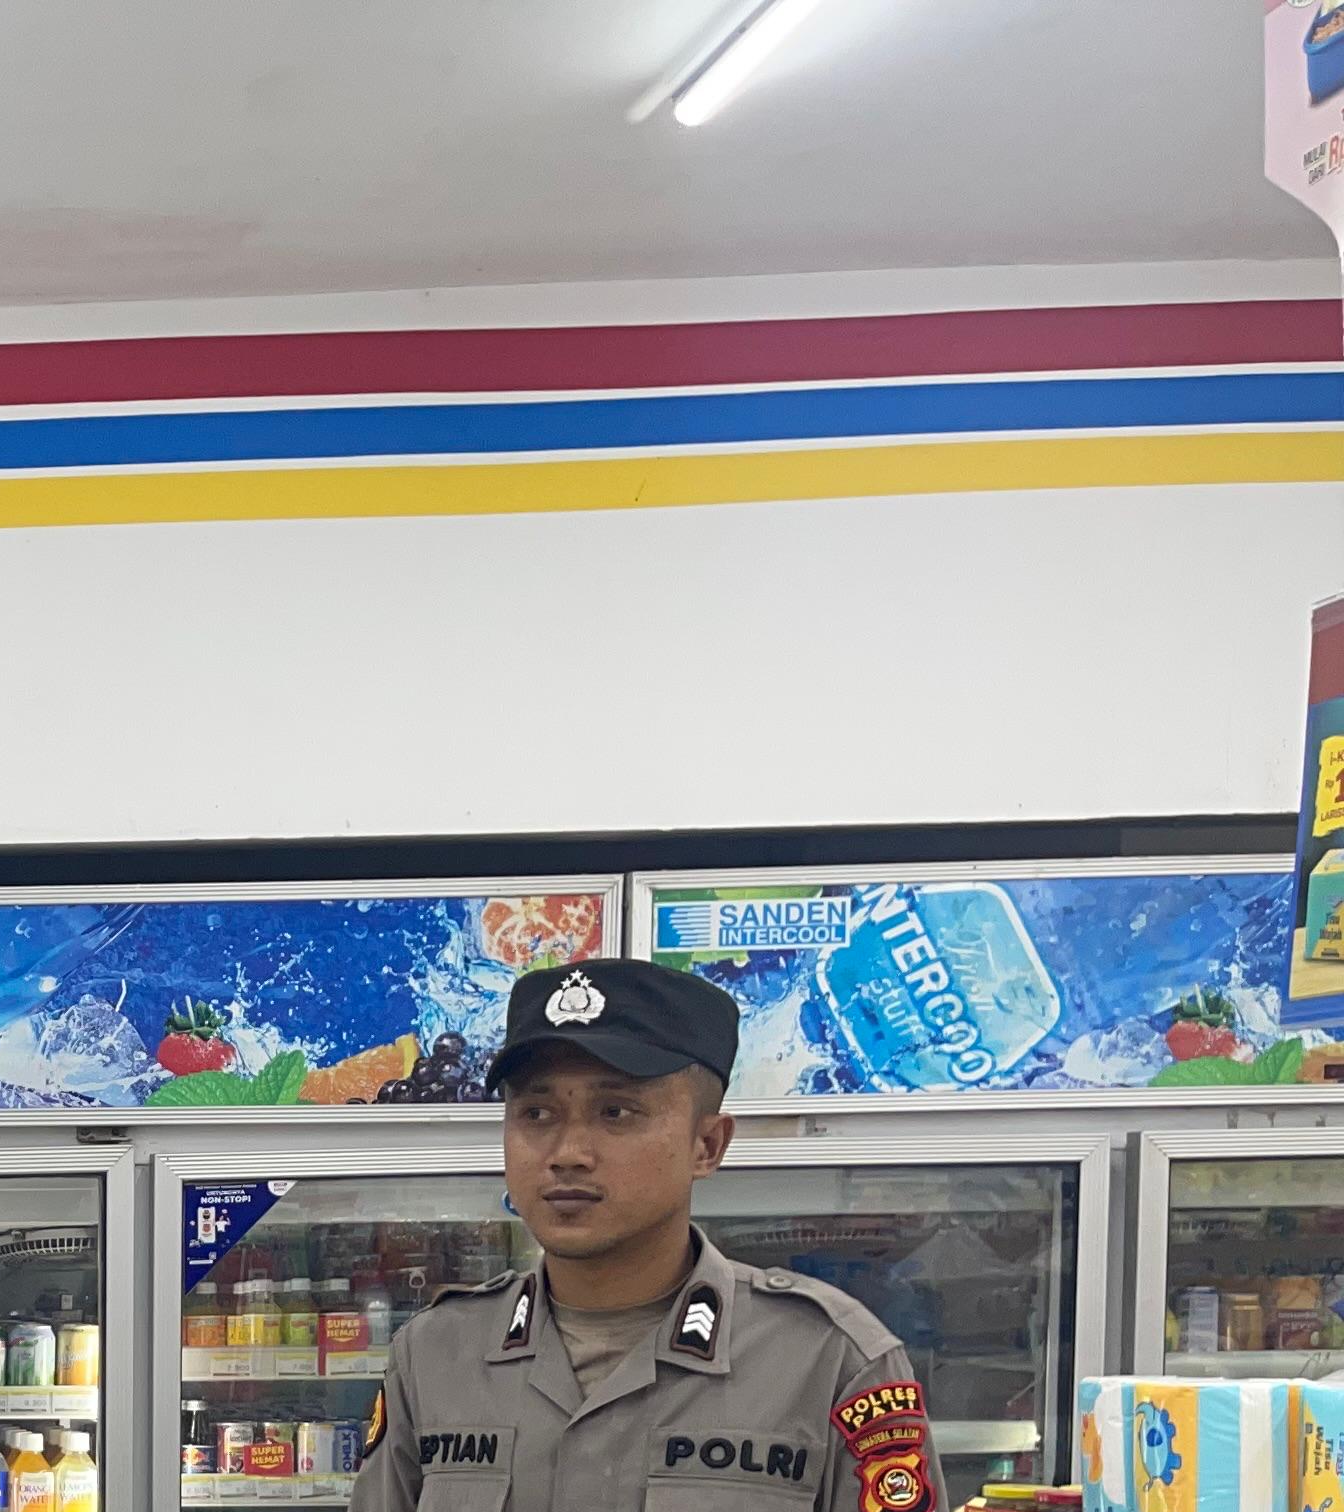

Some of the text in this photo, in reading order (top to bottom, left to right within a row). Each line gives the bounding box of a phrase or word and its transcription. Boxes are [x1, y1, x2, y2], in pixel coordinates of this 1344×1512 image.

[719, 902, 847, 925] SANDEN
[721, 927, 843, 944] INTERCOOL
[326, 1319, 360, 1329] SUPER
[326, 1328, 361, 1338] HEMAT
[840, 1387, 916, 1422] POLRES
[852, 1401, 914, 1428] PALI
[251, 1446, 285, 1456] SUPER
[251, 1455, 285, 1464] HEMAT
[664, 1435, 808, 1481] POLRI
[1314, 1426, 1324, 1475] Wajah
